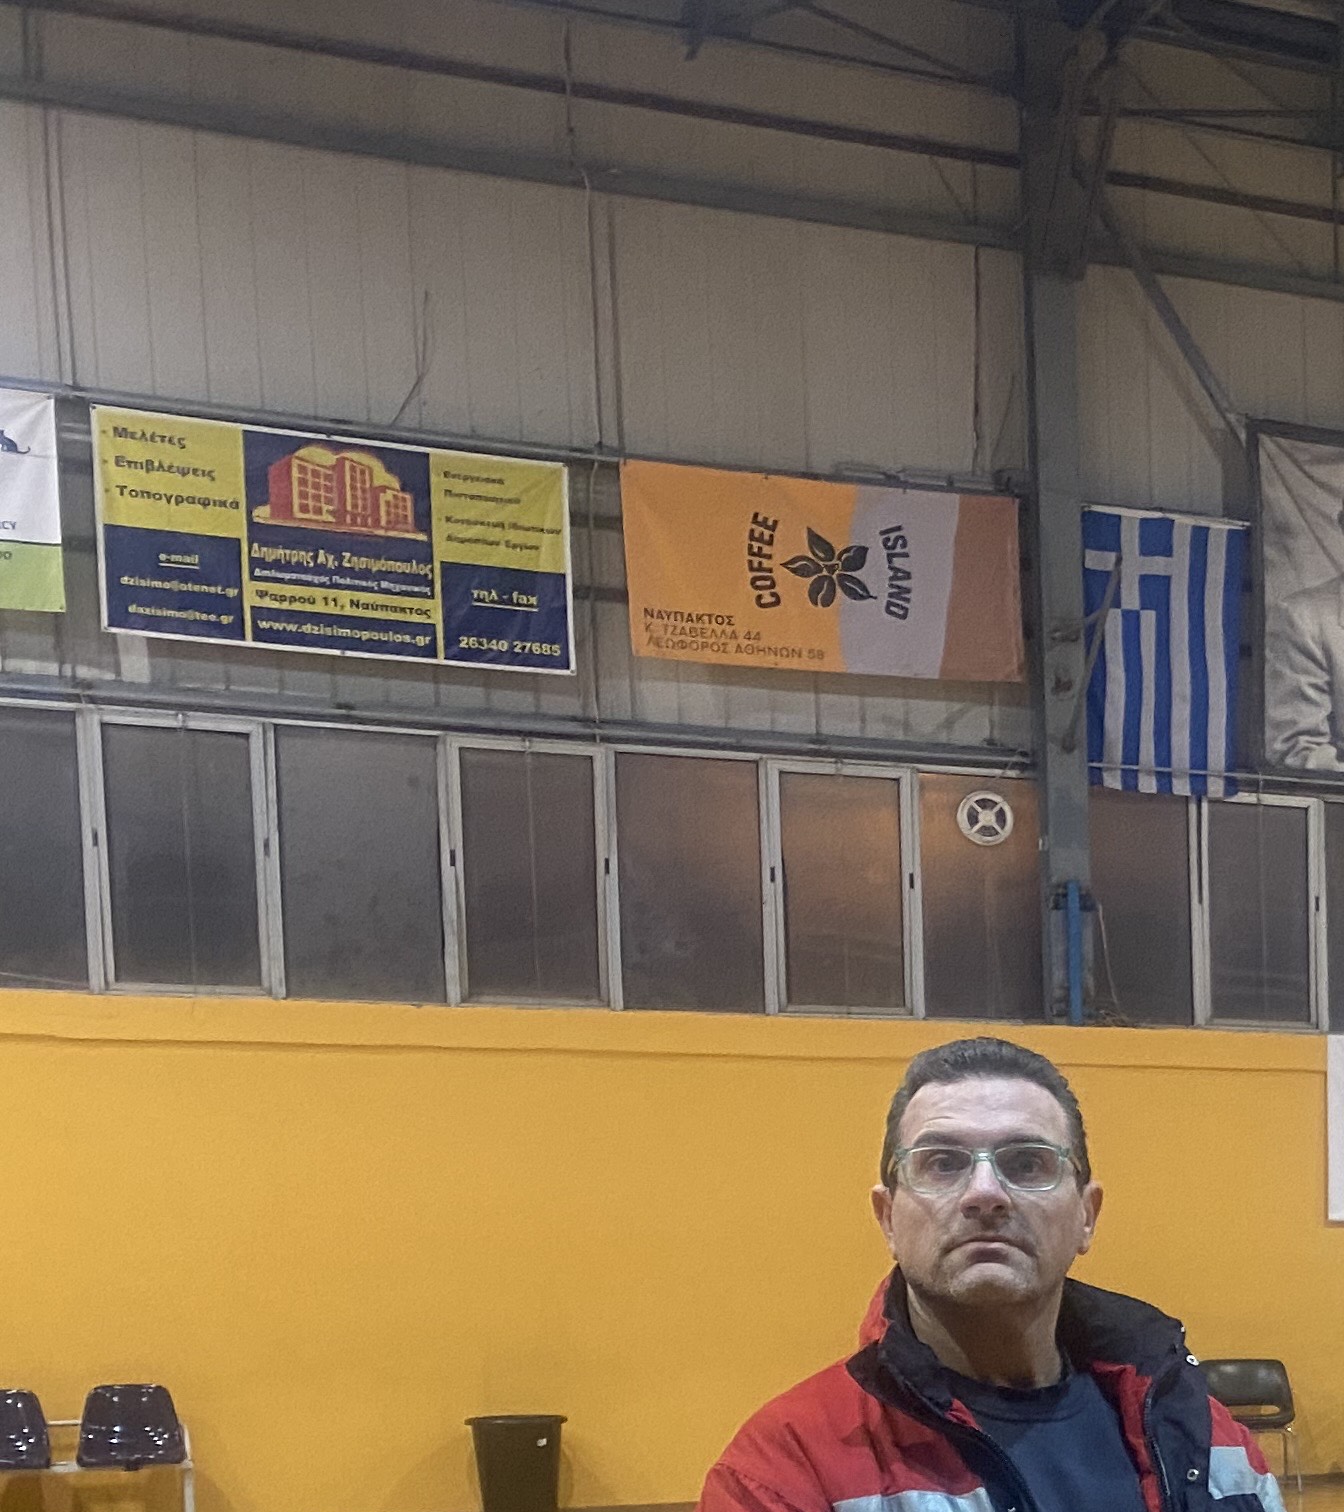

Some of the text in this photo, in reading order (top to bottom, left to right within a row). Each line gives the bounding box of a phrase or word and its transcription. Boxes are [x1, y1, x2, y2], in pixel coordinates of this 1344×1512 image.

[112, 426, 186, 449] Μελέτες
[114, 455, 216, 481] Επιβλέψεις
[115, 485, 240, 509] Τοπογραφικά
[159, 553, 199, 564] e-mail
[251, 542, 314, 568] Δημήτρης
[341, 551, 432, 580] Ζησιμόπουλος
[747, 512, 780, 609] COFFEE
[879, 524, 912, 621] ISLAND
[255, 589, 317, 606] Ψαρρού
[350, 598, 431, 620] Ναύπακτος
[512, 591, 538, 606] fax
[643, 607, 735, 626] ΝΑΥΠΑΚΤΟΣ
[257, 619, 432, 647] www.dzisimopoulos.gr
[647, 635, 731, 655] ΛΕΩΦΟΡΟΣ
[459, 636, 561, 656] 26340 27685
